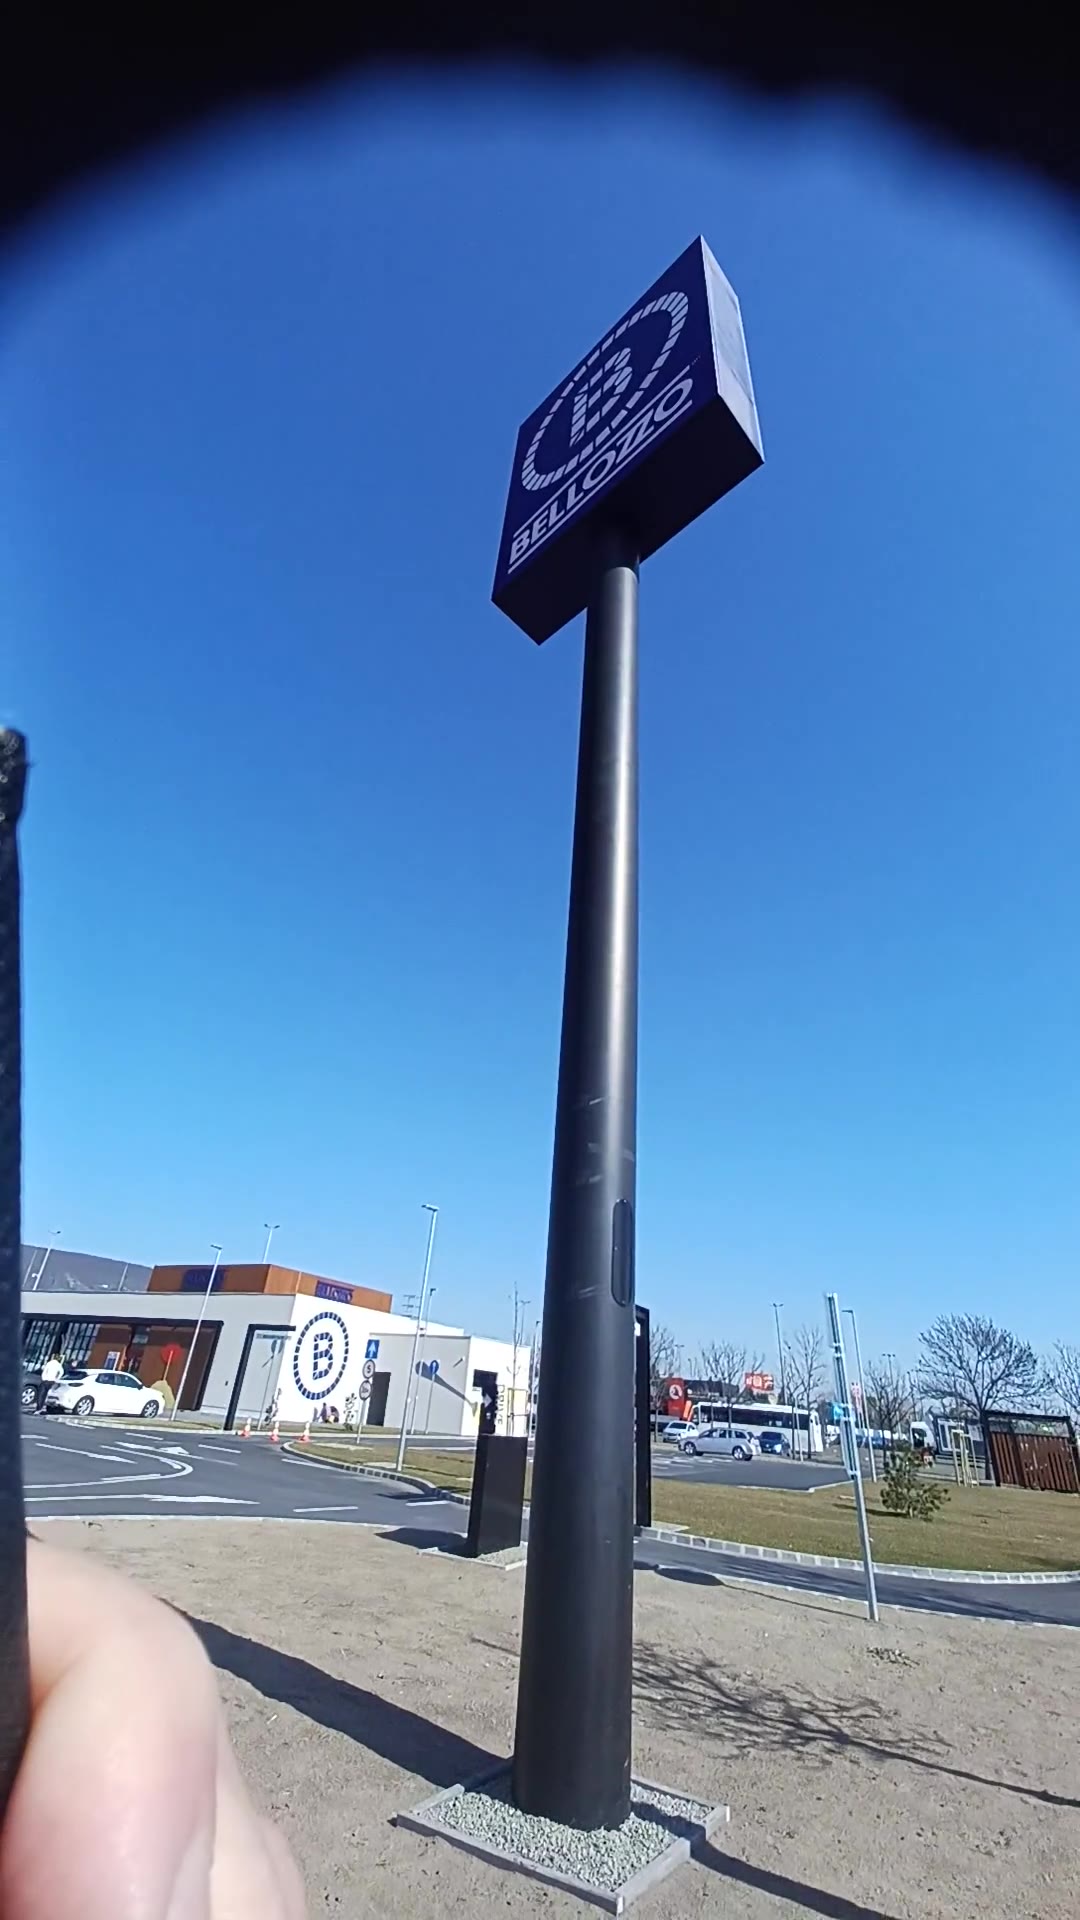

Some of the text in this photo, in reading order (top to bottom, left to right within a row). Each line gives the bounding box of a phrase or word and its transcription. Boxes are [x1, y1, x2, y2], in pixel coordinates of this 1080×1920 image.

[570, 347, 632, 447] B
[510, 378, 694, 564] BELLOZZO
[313, 1332, 333, 1380] B
